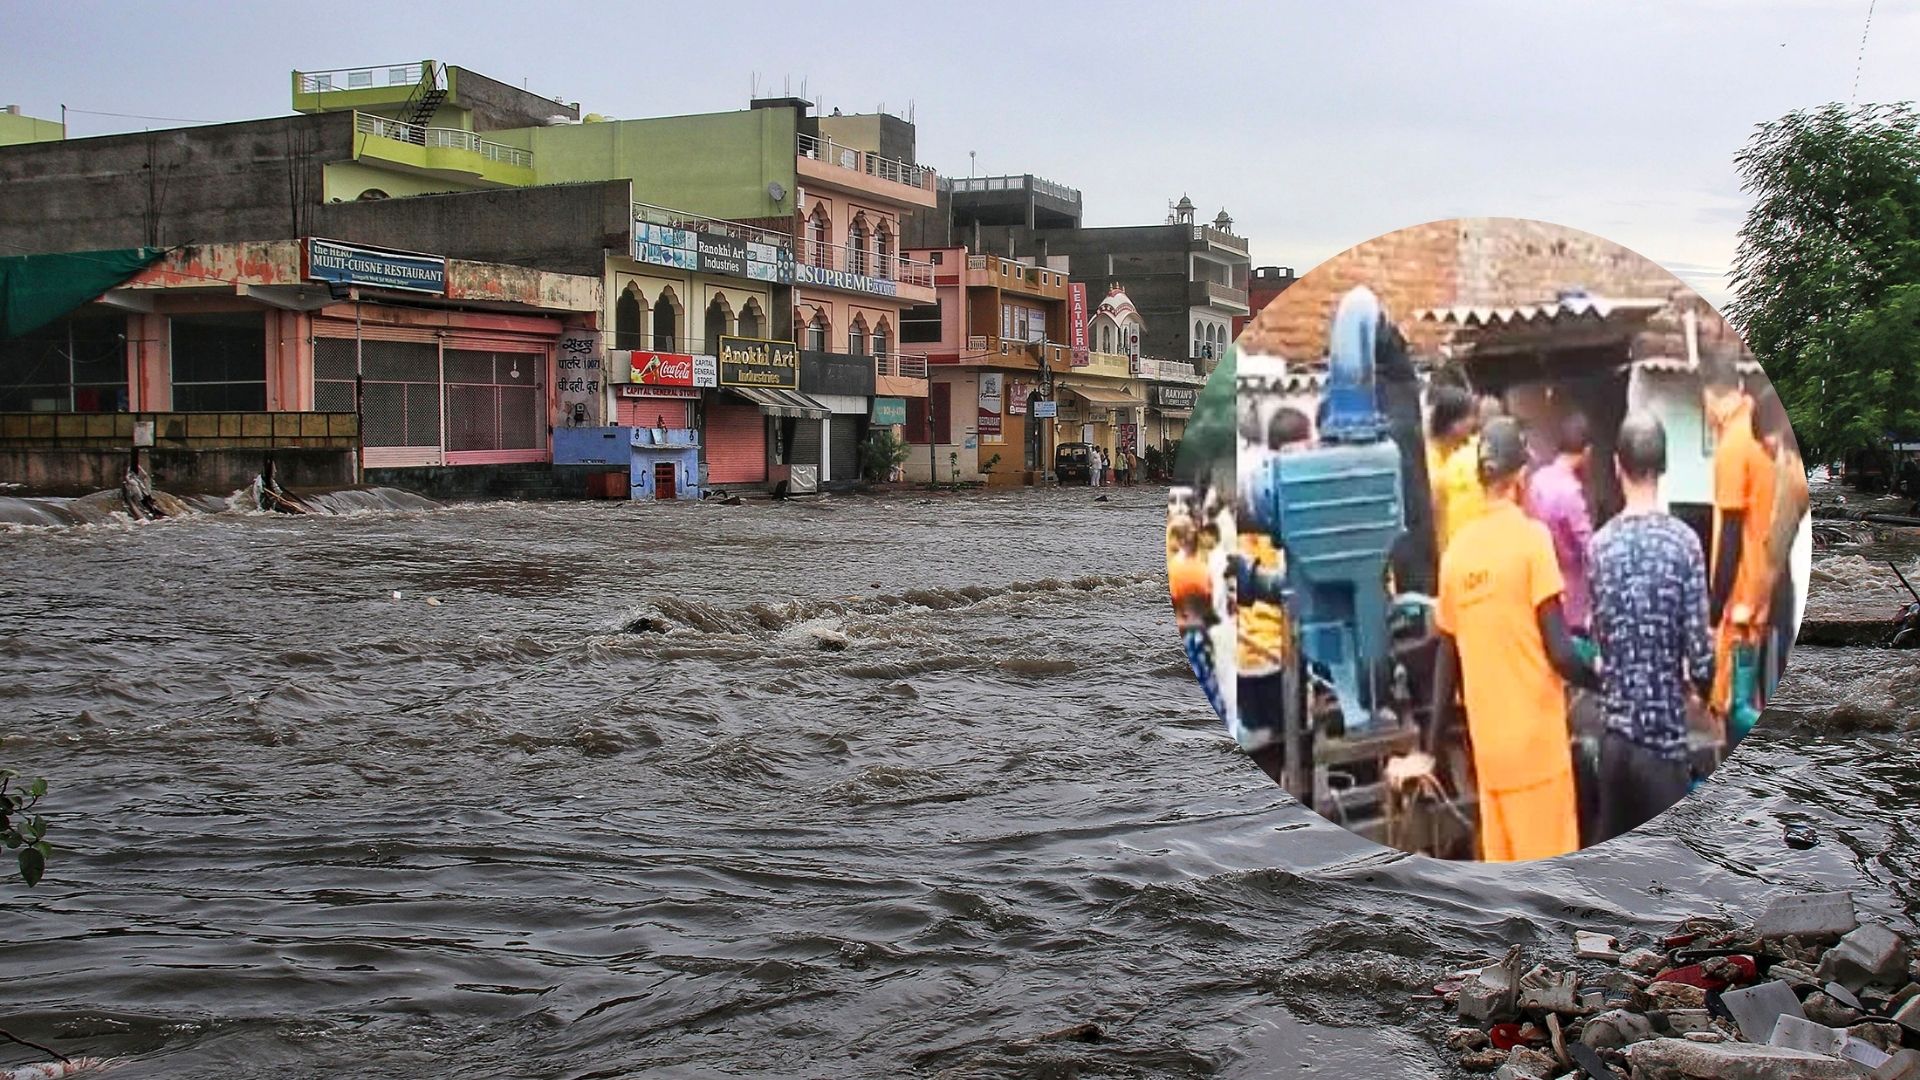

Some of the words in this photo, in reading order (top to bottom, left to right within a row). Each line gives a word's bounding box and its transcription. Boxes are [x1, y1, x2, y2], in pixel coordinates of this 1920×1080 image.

[314, 245, 328, 255] the
[698, 240, 731, 257] Ranokhi
[732, 247, 745, 259] Art
[313, 255, 382, 274] MULTI-CUISNE
[384, 265, 443, 282] RESTAURANT
[704, 256, 740, 272] Industries
[805, 265, 875, 293] SUPREME
[1073, 285, 1084, 346] LEATHER
[695, 359, 714, 367] CAPITAL
[722, 343, 770, 366] Anokhi
[773, 350, 795, 368] Art
[694, 367, 715, 376] GENERAL
[738, 369, 781, 384] Industries
[697, 376, 713, 384] STORE
[626, 387, 651, 396] CAPITAL
[653, 388, 678, 397] GENERAL
[680, 389, 697, 397] STORE
